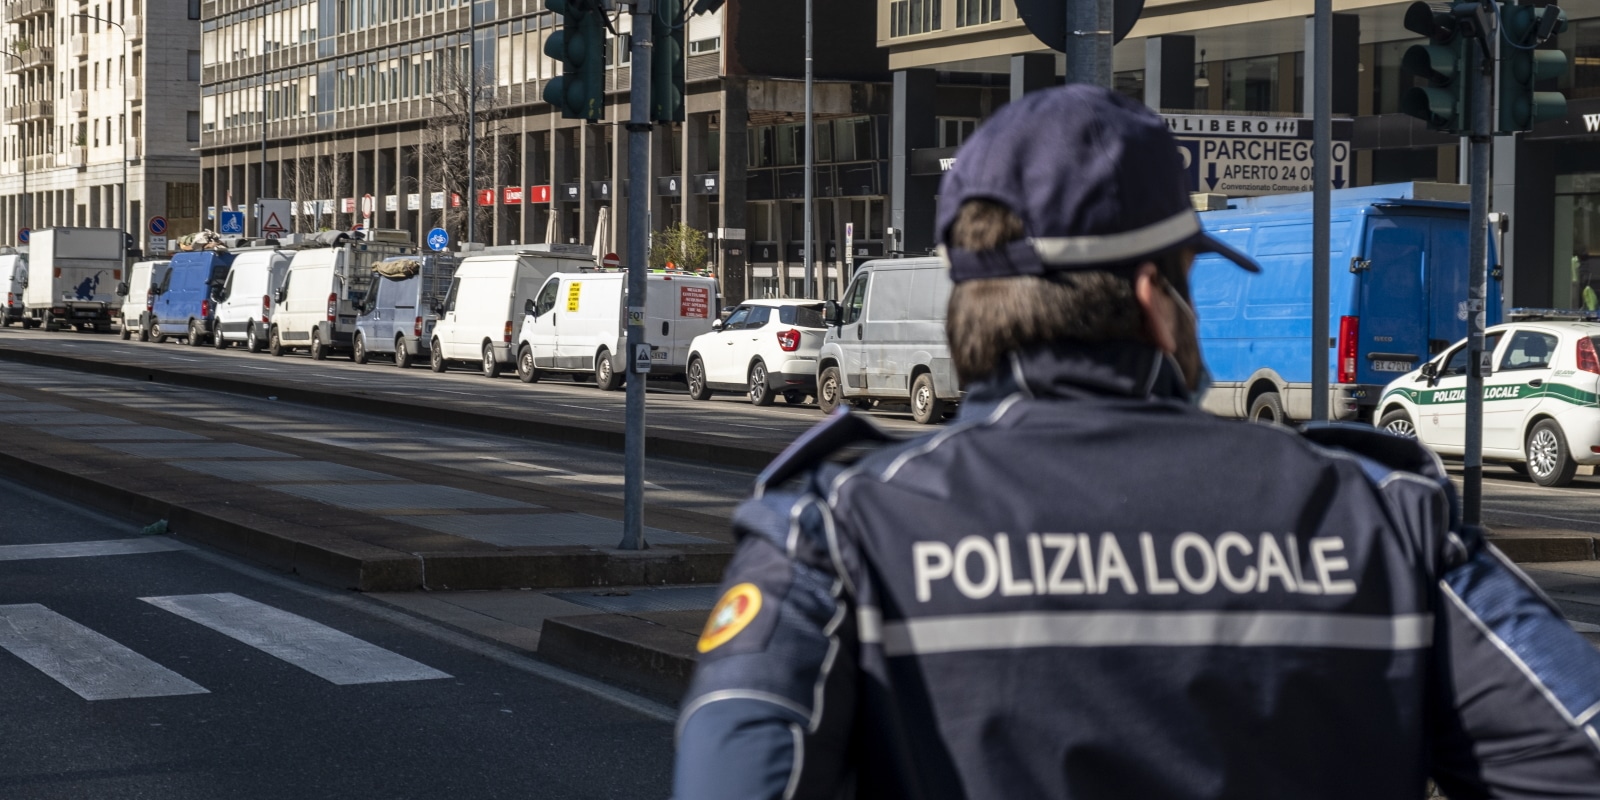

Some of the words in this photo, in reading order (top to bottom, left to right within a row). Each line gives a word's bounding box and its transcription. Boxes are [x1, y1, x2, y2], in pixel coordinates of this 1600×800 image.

[1184, 119, 1268, 133] LIBERO
[1204, 140, 1347, 162] PARCHEGO
[1223, 165, 1278, 180] APERTO
[1282, 166, 1296, 180] 24
[1221, 183, 1270, 191] Convenzionato
[1272, 184, 1300, 192] Comune
[1433, 389, 1466, 402] POLIZIA
[1484, 386, 1520, 399] LOCALE
[912, 532, 1138, 602] POLIZIA
[1139, 532, 1357, 595] LOCALE
